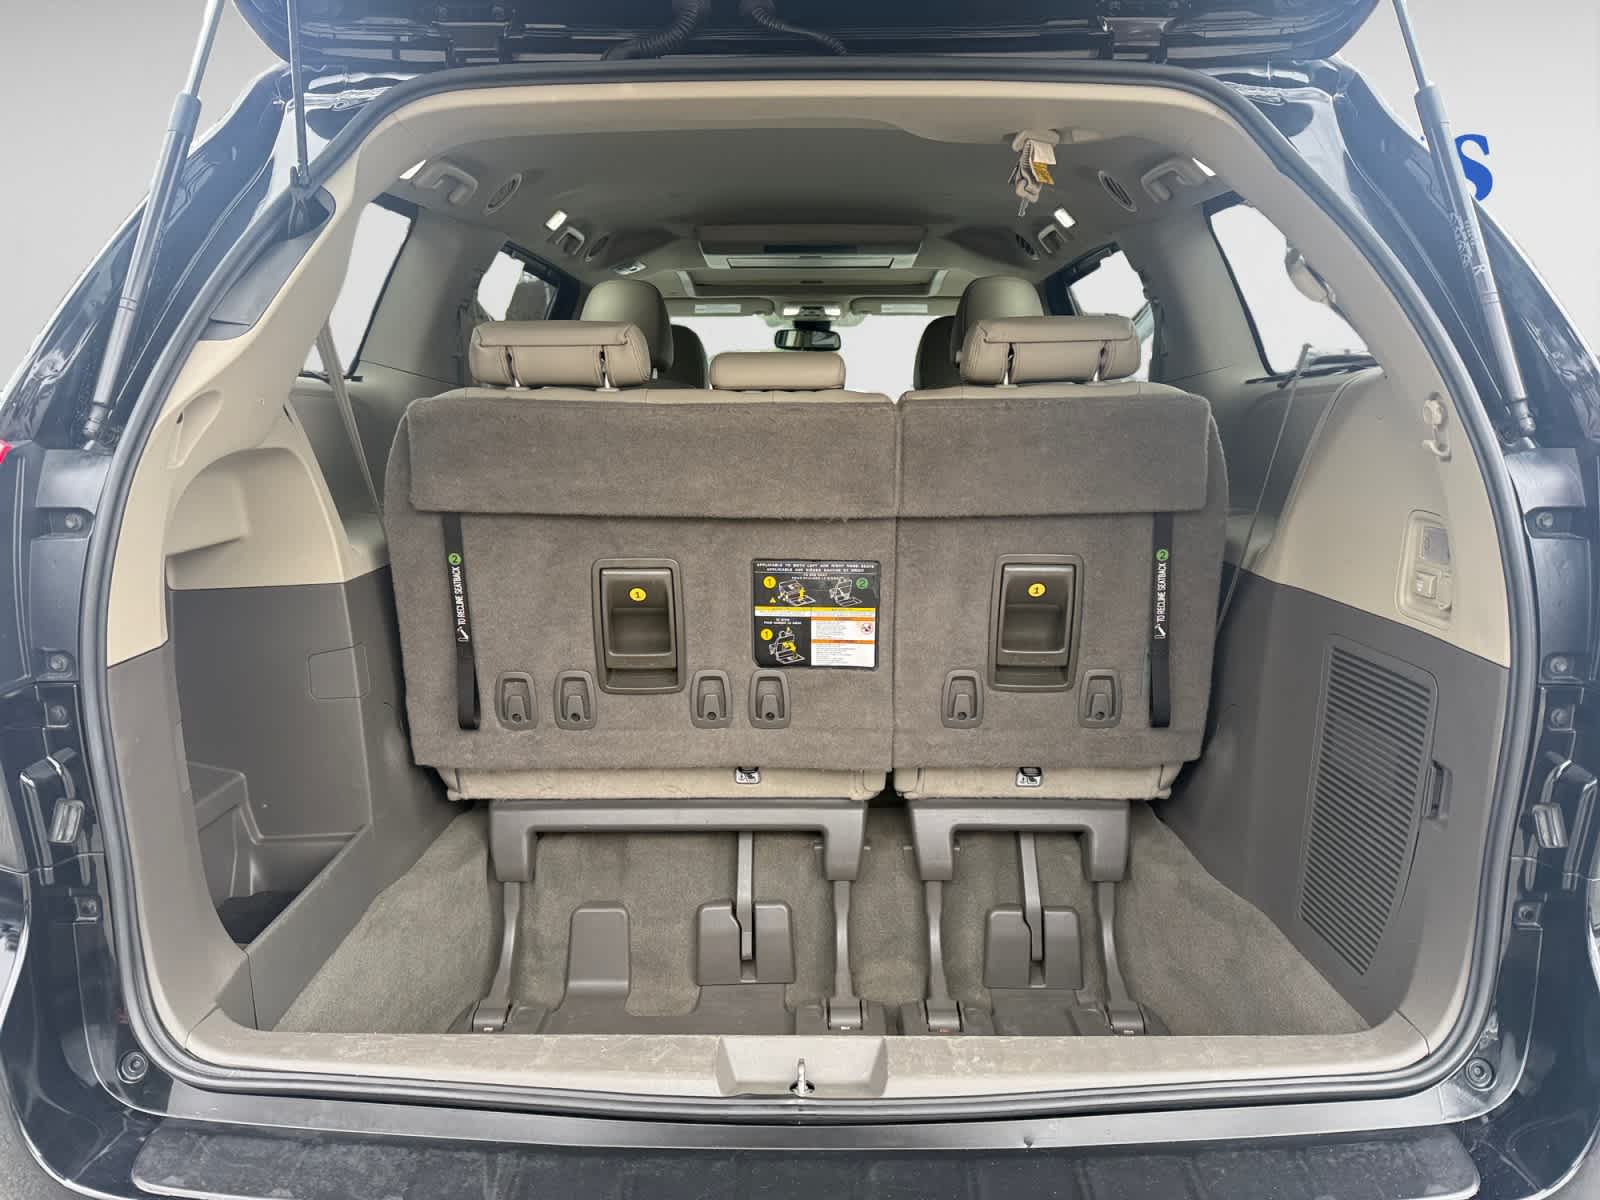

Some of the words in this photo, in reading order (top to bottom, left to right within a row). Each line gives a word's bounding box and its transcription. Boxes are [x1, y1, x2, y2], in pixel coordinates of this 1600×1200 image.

[451, 566, 463, 595] SEATBACK
[1157, 562, 1167, 591] SEATBACK
[455, 594, 466, 618] RECLINE
[1156, 591, 1166, 615] RECLINE
[457, 618, 466, 626] TO
[1156, 615, 1166, 623] TO
